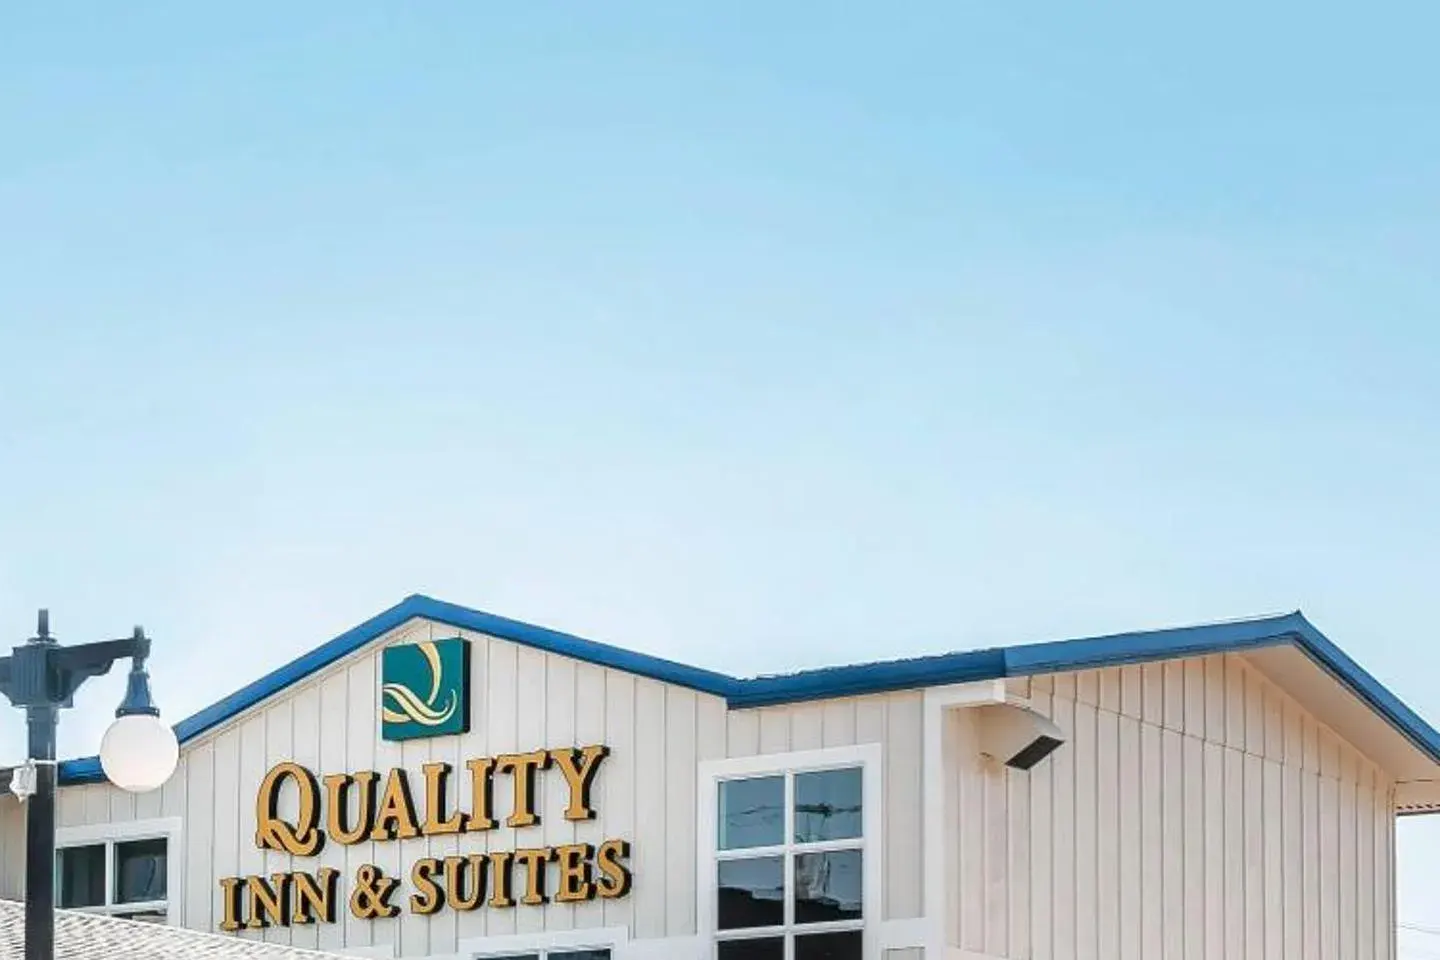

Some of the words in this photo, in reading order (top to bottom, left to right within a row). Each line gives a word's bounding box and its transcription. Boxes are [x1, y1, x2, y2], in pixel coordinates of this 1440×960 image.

[255, 745, 610, 857] QUALITY
[219, 866, 340, 932] INN
[349, 864, 401, 919] &
[410, 839, 632, 915] SUITES
